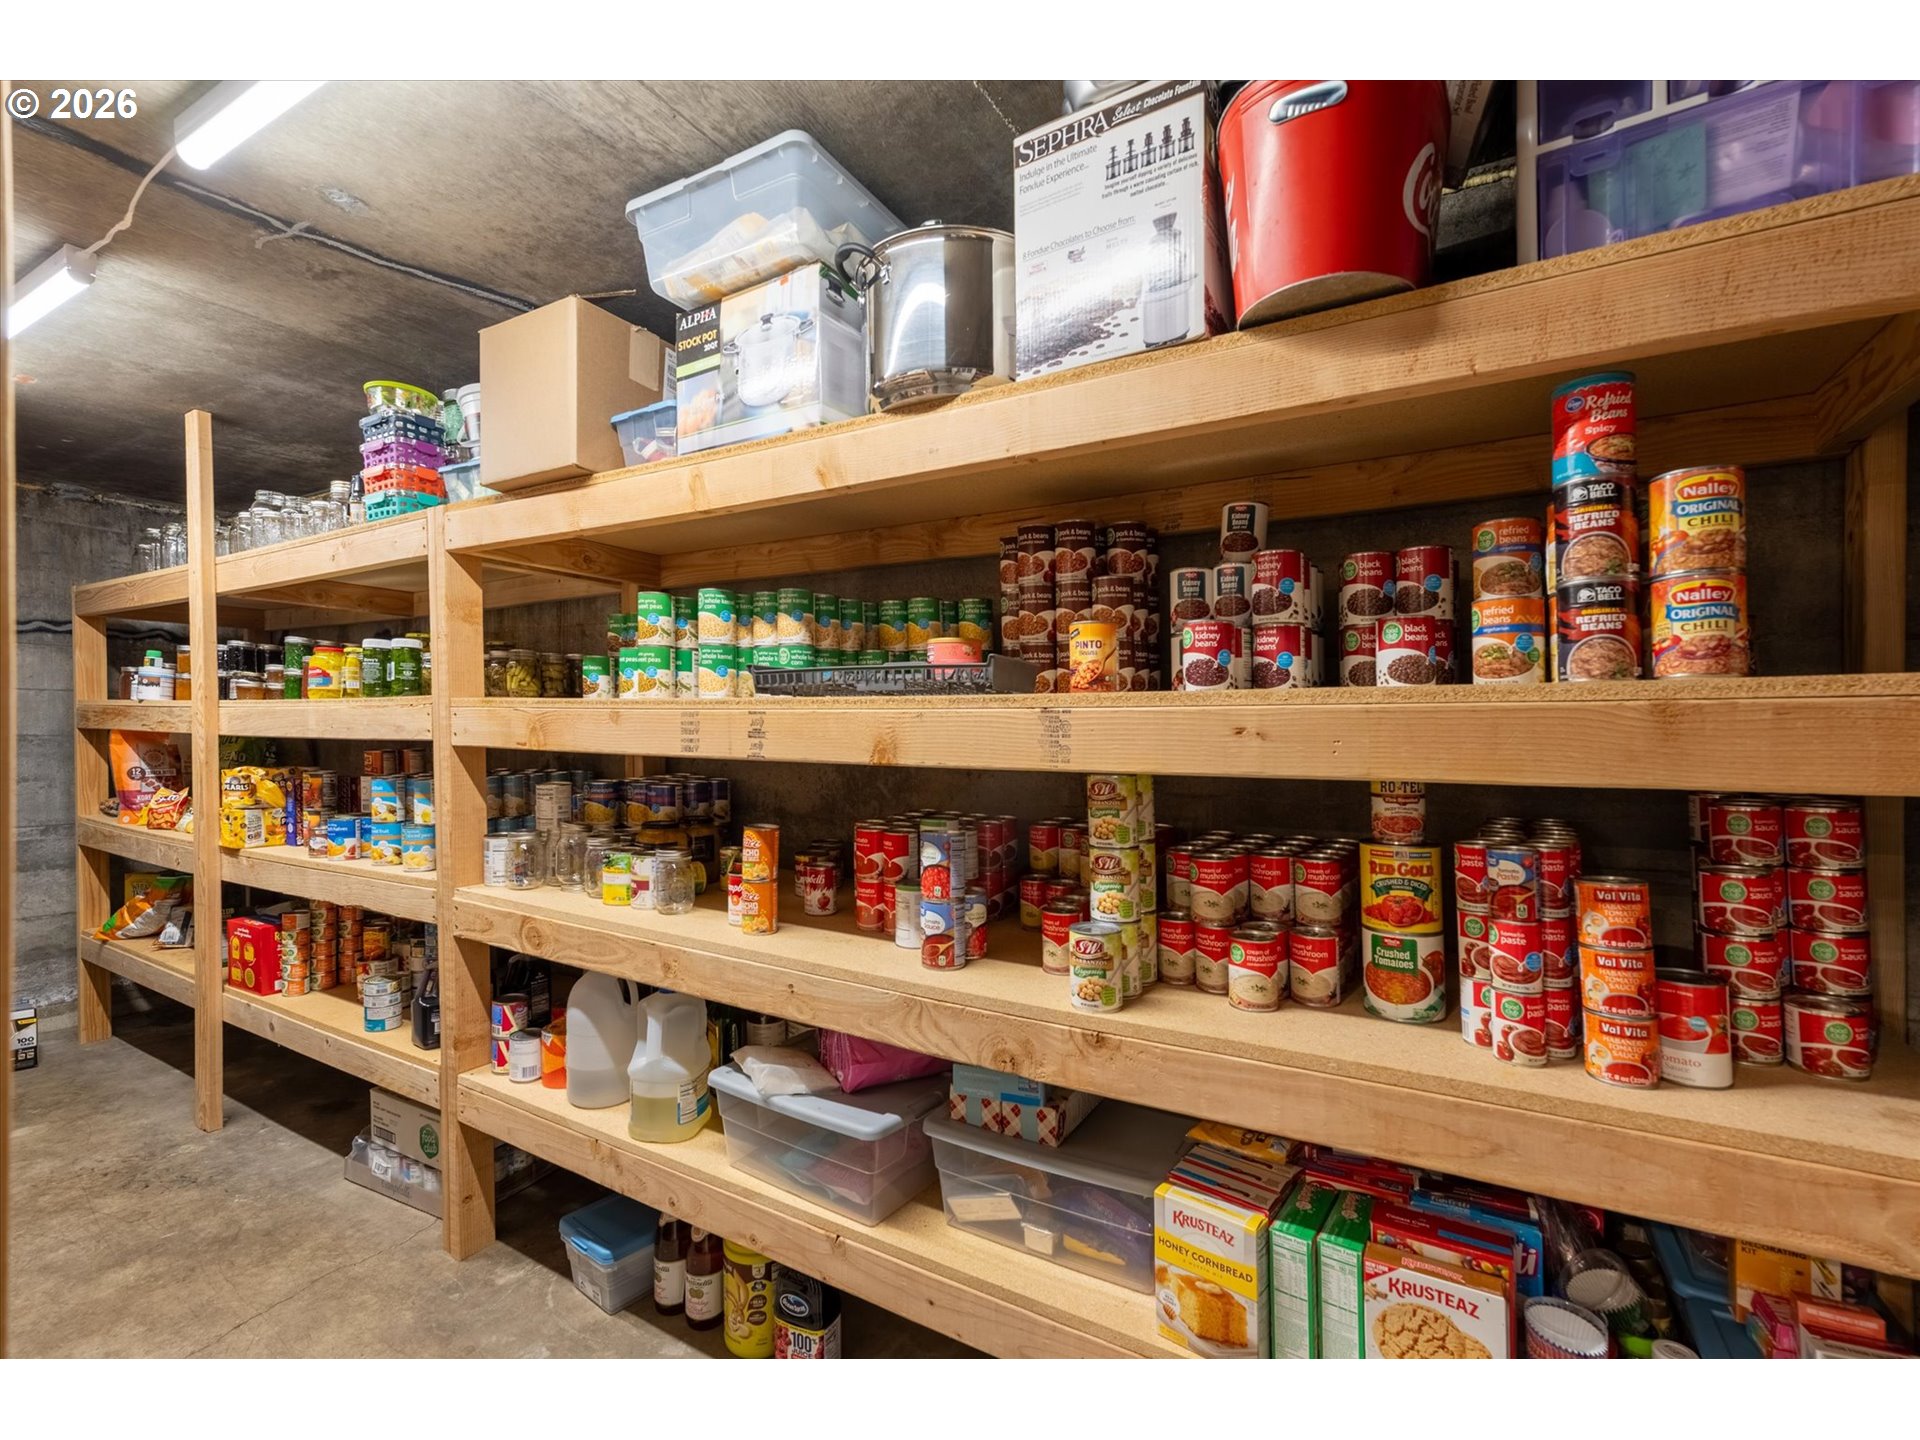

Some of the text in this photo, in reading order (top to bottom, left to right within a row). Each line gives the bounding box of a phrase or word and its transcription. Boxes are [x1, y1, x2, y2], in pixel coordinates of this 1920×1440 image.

[1018, 90, 1173, 167] SEPHRA Select Chocolate
[1019, 144, 1097, 182] Indulge in the Ultimate
[1019, 178, 1045, 195] Fondue
[1027, 245, 1050, 258] Fondue
[1050, 233, 1084, 251] Chocolates
[1085, 230, 1091, 238] to
[1092, 221, 1117, 235] Choose
[679, 307, 717, 331] ALPHA
[678, 329, 718, 351] STOCK POT
[1585, 390, 1632, 410] Refried
[1590, 408, 1628, 423] Beans
[1588, 483, 1615, 492] TACO
[1683, 483, 1736, 497] Nalley
[1589, 490, 1616, 499] BELL
[1676, 500, 1740, 515] ORIGINAL
[1231, 512, 1250, 520] Kidney
[1568, 510, 1620, 524] REFRIED
[1687, 514, 1734, 527] CHILI
[1574, 518, 1616, 530] BEANS
[1075, 528, 1091, 536] beans
[1115, 530, 1129, 538] pork
[1499, 525, 1529, 536] refried
[1499, 534, 1528, 544] beans
[1257, 561, 1281, 572] kidney
[1360, 560, 1380, 569] black
[1401, 565, 1424, 574] beans
[1257, 569, 1279, 577] beans
[1360, 569, 1383, 577] beans
[1596, 586, 1622, 594] TACO
[1676, 588, 1732, 602] Nalley
[704, 597, 720, 605] whole
[1597, 592, 1622, 601] BELL
[1482, 605, 1514, 616] refried
[1670, 606, 1736, 621] ORIGINAL
[1483, 614, 1511, 625] beans
[1576, 613, 1627, 625] REFRIED
[1404, 624, 1427, 633] black
[1581, 621, 1623, 632] BEANS
[1680, 620, 1728, 632] CHILI
[1194, 631, 1220, 641] kidney
[1256, 634, 1280, 645] kidney
[1404, 632, 1429, 641] beans
[1075, 640, 1103, 650] PINTO
[1194, 639, 1218, 648] beans
[1256, 642, 1277, 651] beans
[131, 768, 141, 776] 12
[1369, 859, 1434, 877] RED GOLD
[1461, 859, 1484, 868] paste
[1541, 863, 1565, 872] paste
[1375, 879, 1403, 889] CRUSHED
[1410, 879, 1428, 890] DICED
[1597, 890, 1641, 902] Val Vita
[1604, 909, 1639, 917] TOMATO
[1608, 916, 1635, 924] SAUCE
[1500, 930, 1526, 938] tomato
[1541, 933, 1566, 941] paste
[1501, 936, 1527, 946] paste
[1376, 946, 1410, 960] Crushed
[1373, 954, 1414, 970] Tomatoes
[1596, 955, 1644, 969] Val Vita
[1605, 975, 1640, 984] TOMATO
[1609, 982, 1635, 991] SAUCE
[1547, 1003, 1570, 1012] paste
[1601, 1022, 1648, 1038] Val Vita
[17, 1036, 34, 1044] 100
[1609, 1042, 1644, 1053] TOMATO
[1613, 1049, 1640, 1060] SAUCE
[1662, 1054, 1702, 1068] omato
[422, 1130, 436, 1142] food
[424, 1142, 438, 1154] club
[1172, 1209, 1235, 1248] KRUSTEAZ
[1741, 1245, 1757, 1256] KIT
[1158, 1235, 1190, 1257] HONEY
[1191, 1251, 1254, 1284] CORNBREAD
[1388, 1277, 1481, 1320] KRUSTEAZ
